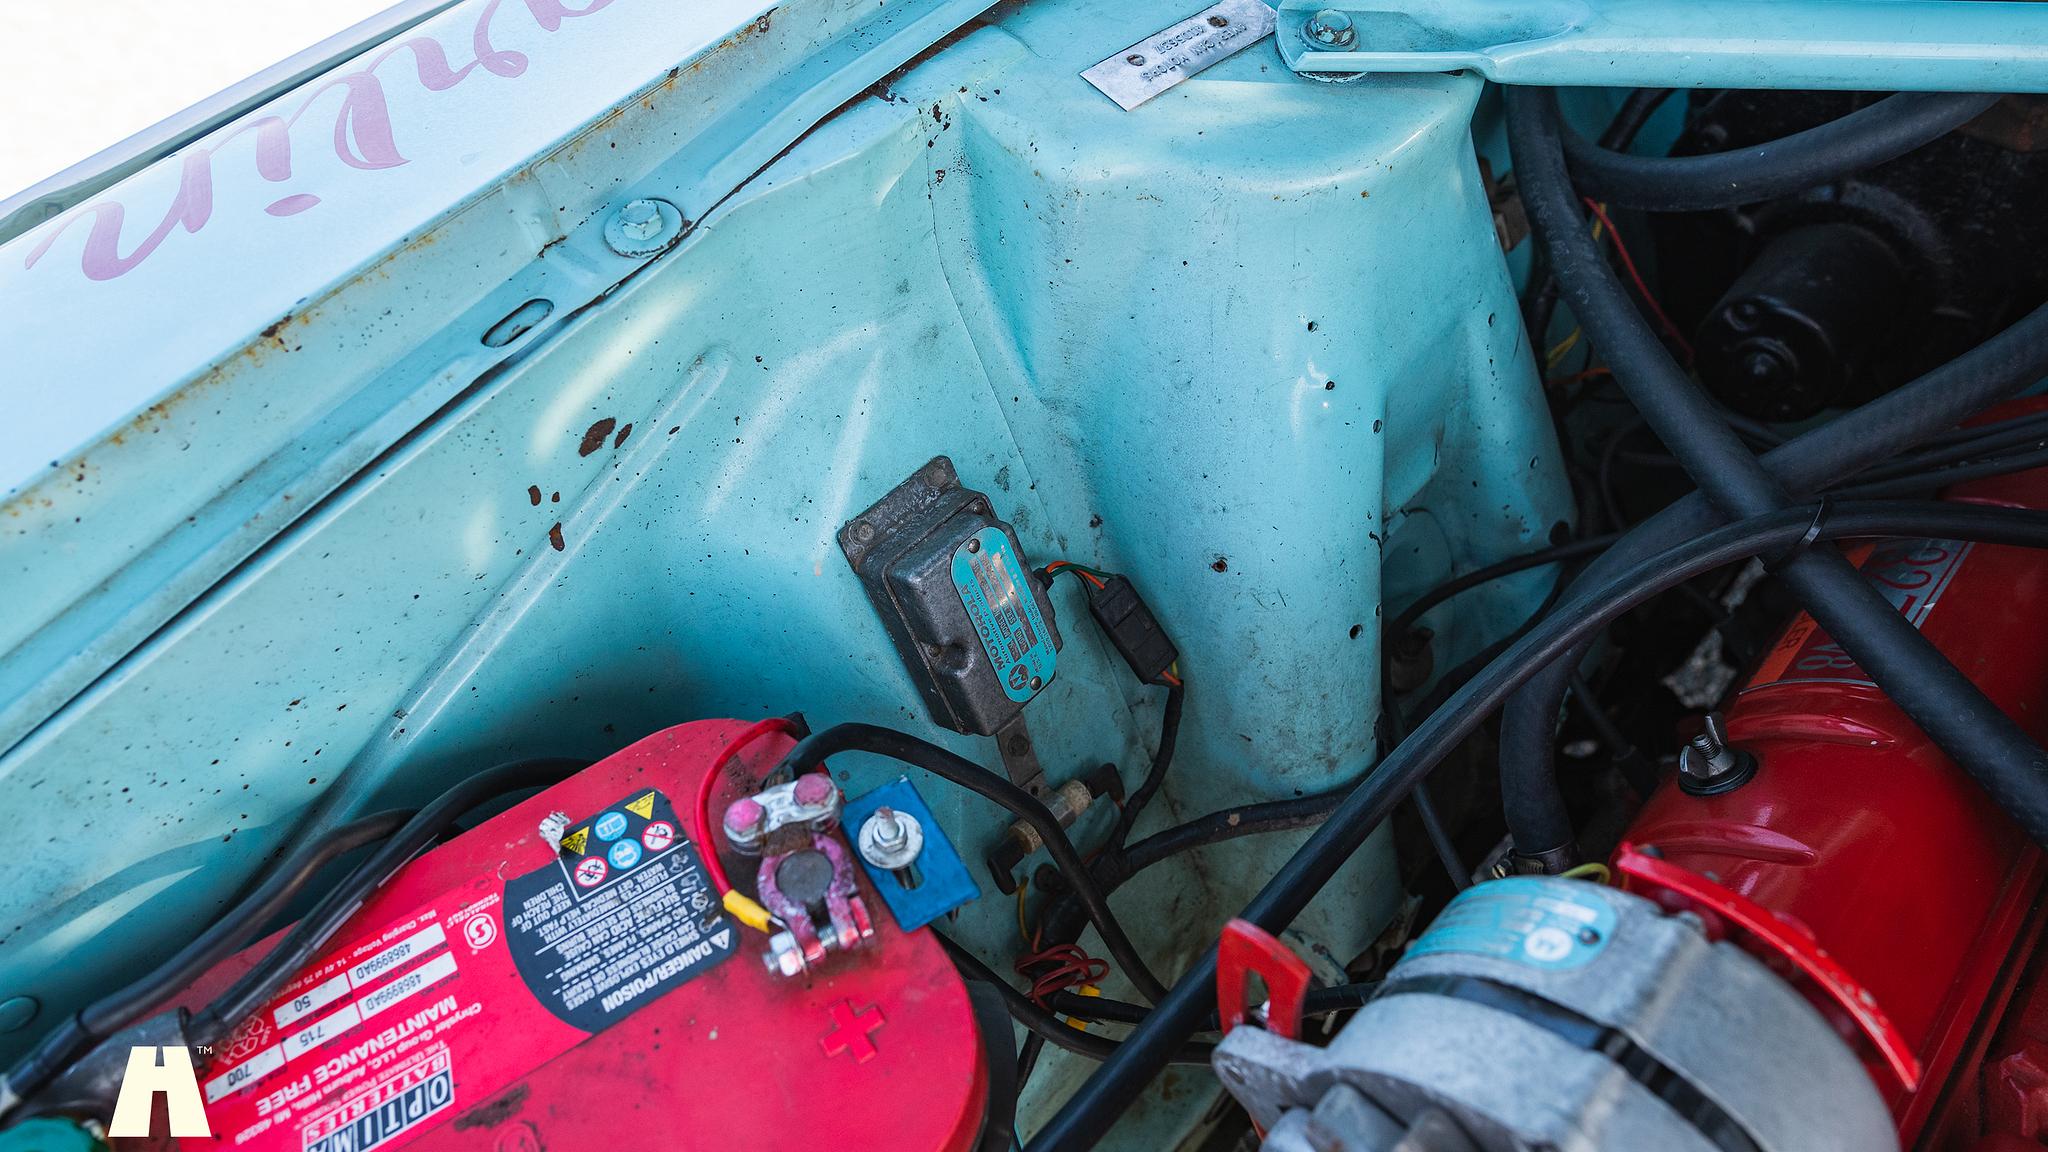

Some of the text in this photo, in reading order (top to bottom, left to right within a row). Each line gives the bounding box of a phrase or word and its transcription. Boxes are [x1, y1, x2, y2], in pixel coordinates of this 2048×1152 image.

[1141, 55, 1189, 83] MOTORS
[967, 577, 989, 617] Products
[958, 583, 1006, 671] MOTOROLA
[995, 615, 1010, 637] MODEL
[985, 617, 1011, 665] Automotive
[640, 869, 668, 890] FLUSH
[512, 890, 568, 927] THE REACH OF
[524, 883, 564, 910] CHILDREN
[536, 863, 664, 937] WATER. GET MEDICAL HELP FAST.
[418, 910, 436, 922] Max.
[520, 899, 572, 932] KEEP OUT OF
[553, 883, 675, 954] BLINDNESS OR SEVERE BURNS
[561, 891, 680, 961] SULFURIC ACID CAN CAUSE
[568, 895, 620, 930] IMMEDIATELY
[672, 906, 688, 920] NO
[382, 920, 416, 941] Charging
[542, 926, 567, 943] WITH
[354, 939, 382, 956] Voltage
[356, 944, 410, 979] 4868999AD
[558, 920, 695, 1001] CAN CAUSE BLINDNESS OR INJURY
[304, 975, 314, 984] 25
[315, 970, 322, 978] at
[557, 954, 600, 982] SMOKING
[564, 928, 700, 1010] SHIELD EYES EXPLOSIVE GASES
[602, 941, 712, 1012] DANGER/POISON
[294, 996, 311, 1012] 50
[366, 974, 420, 1010] 4868999AD
[435, 1003, 481, 1033] Chrysler
[300, 1026, 324, 1046] 715
[314, 996, 457, 1084] MAINTENANCE
[396, 1030, 433, 1053] Group
[426, 1040, 446, 1054] THE
[367, 1049, 396, 1069] LLC,
[378, 1052, 424, 1081] ULTIMATE
[222, 1064, 251, 1086] 700
[323, 1065, 365, 1094] Auburn
[256, 1075, 312, 1116] FREE
[292, 1090, 322, 1109] Hills,
[304, 1053, 449, 1142] BATTERIES
[342, 1078, 377, 1101] POWER
[274, 1108, 291, 1123] MI
